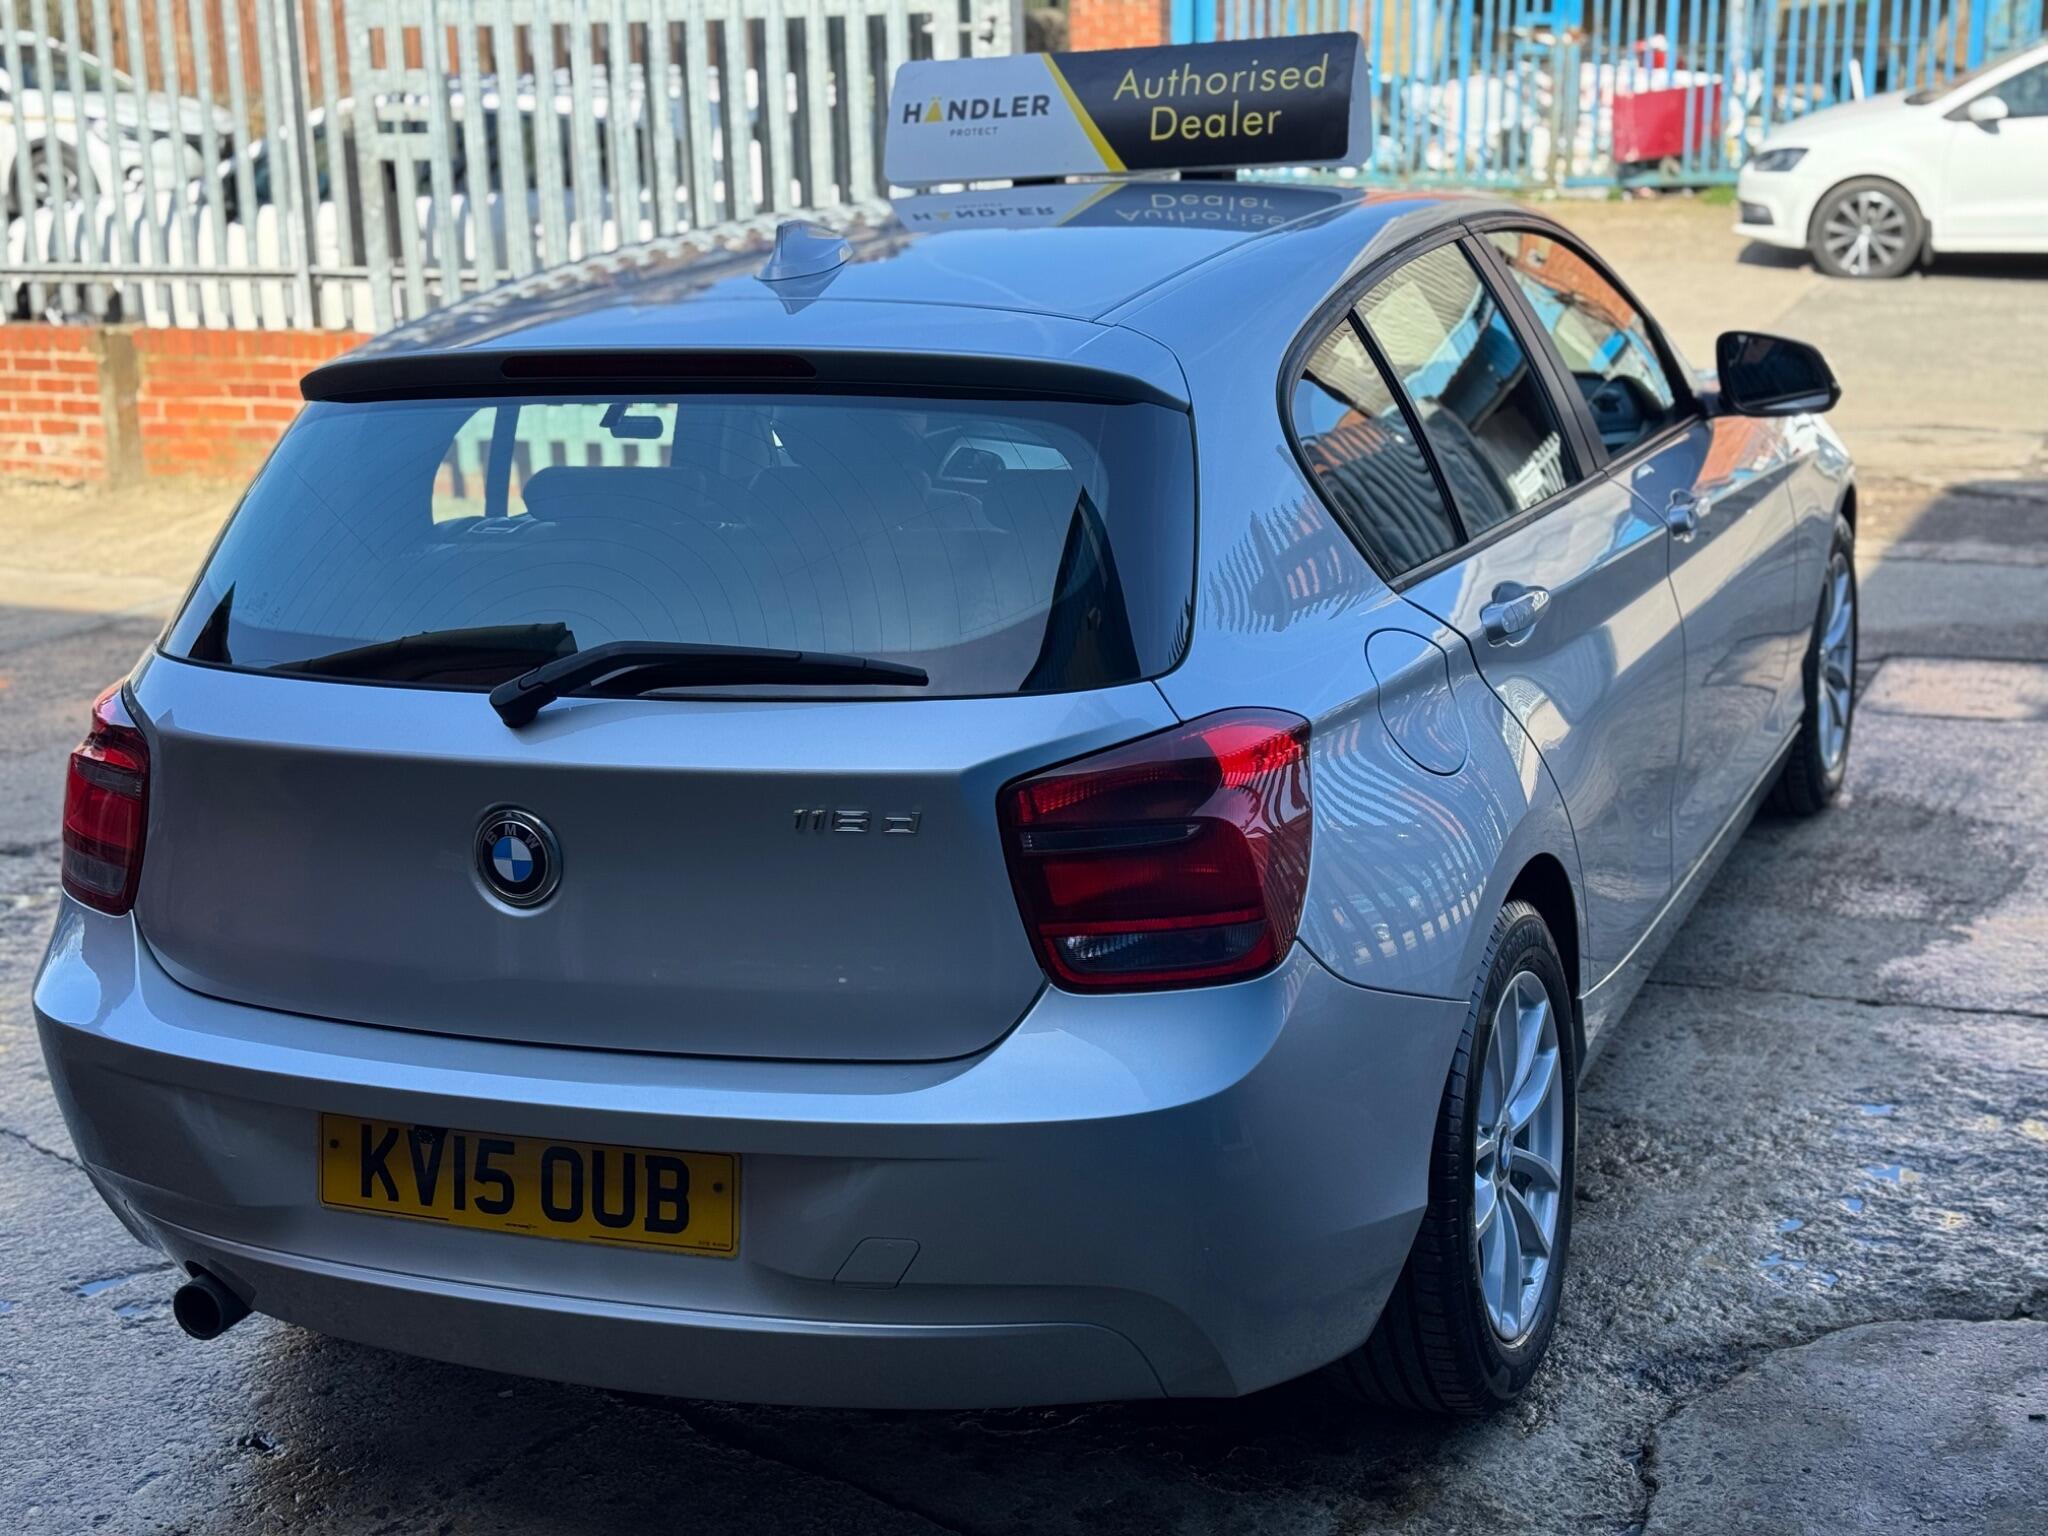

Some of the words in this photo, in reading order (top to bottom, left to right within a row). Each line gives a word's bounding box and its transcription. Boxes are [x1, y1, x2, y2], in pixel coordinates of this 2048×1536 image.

[1113, 53, 1329, 100] Authorised
[950, 127, 998, 136] PROTECT
[1151, 100, 1282, 141] Dealer
[484, 823, 540, 849] BMW
[360, 1123, 515, 1215] KV15
[540, 1146, 690, 1235] OUB
